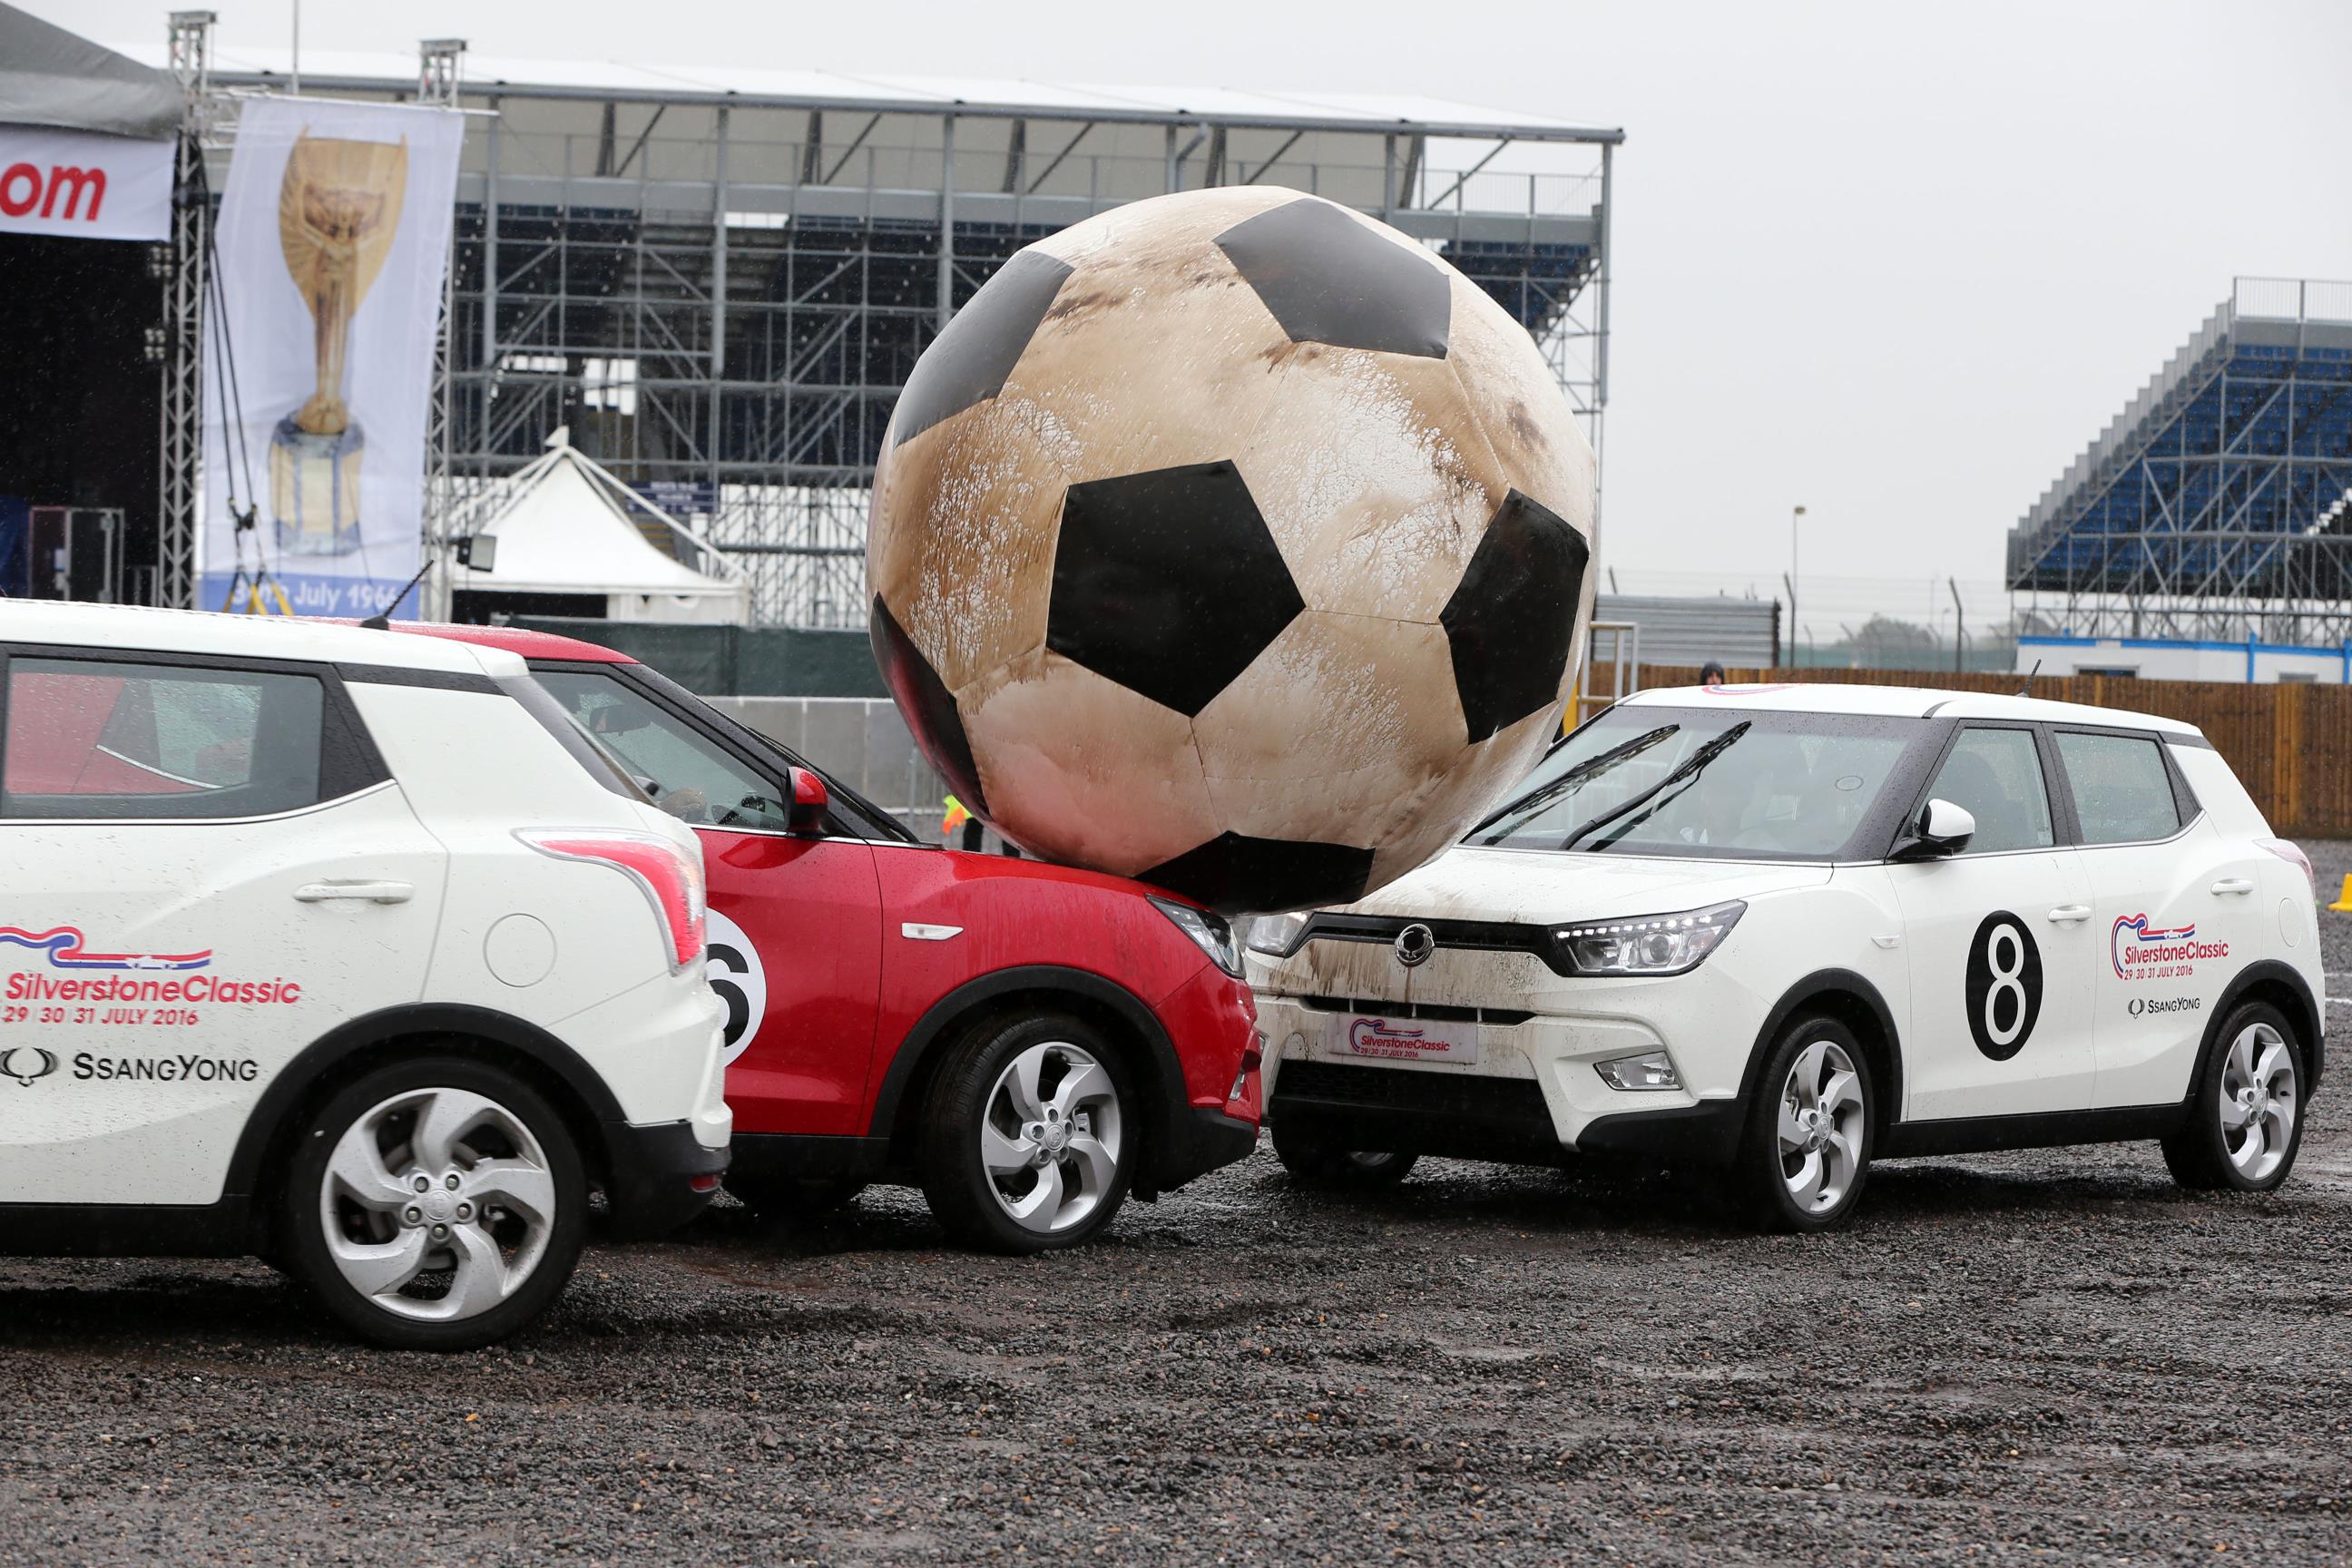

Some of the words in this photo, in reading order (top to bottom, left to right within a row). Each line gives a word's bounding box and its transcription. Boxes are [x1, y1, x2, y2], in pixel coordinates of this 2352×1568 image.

[294, 581, 342, 613] July
[348, 583, 398, 610] 1966
[2124, 939, 2230, 965] SilverstoneClassic
[1984, 923, 2026, 1046] 8
[2124, 969, 2133, 981] 29
[2136, 968, 2145, 980] 30
[2147, 967, 2156, 979] 31
[2157, 966, 2175, 978] JULY
[2176, 965, 2193, 977] 2016
[5, 972, 302, 1004] SilverstoneClassic
[706, 943, 750, 1048] 6
[2, 1005, 29, 1024] 29
[39, 1006, 65, 1024] 30
[73, 1007, 95, 1025] 31
[101, 1008, 149, 1025] JULY
[152, 1008, 201, 1026] 2016
[1361, 1035, 1451, 1052] SilverstoneClassic
[1388, 1049, 1404, 1057] JULY
